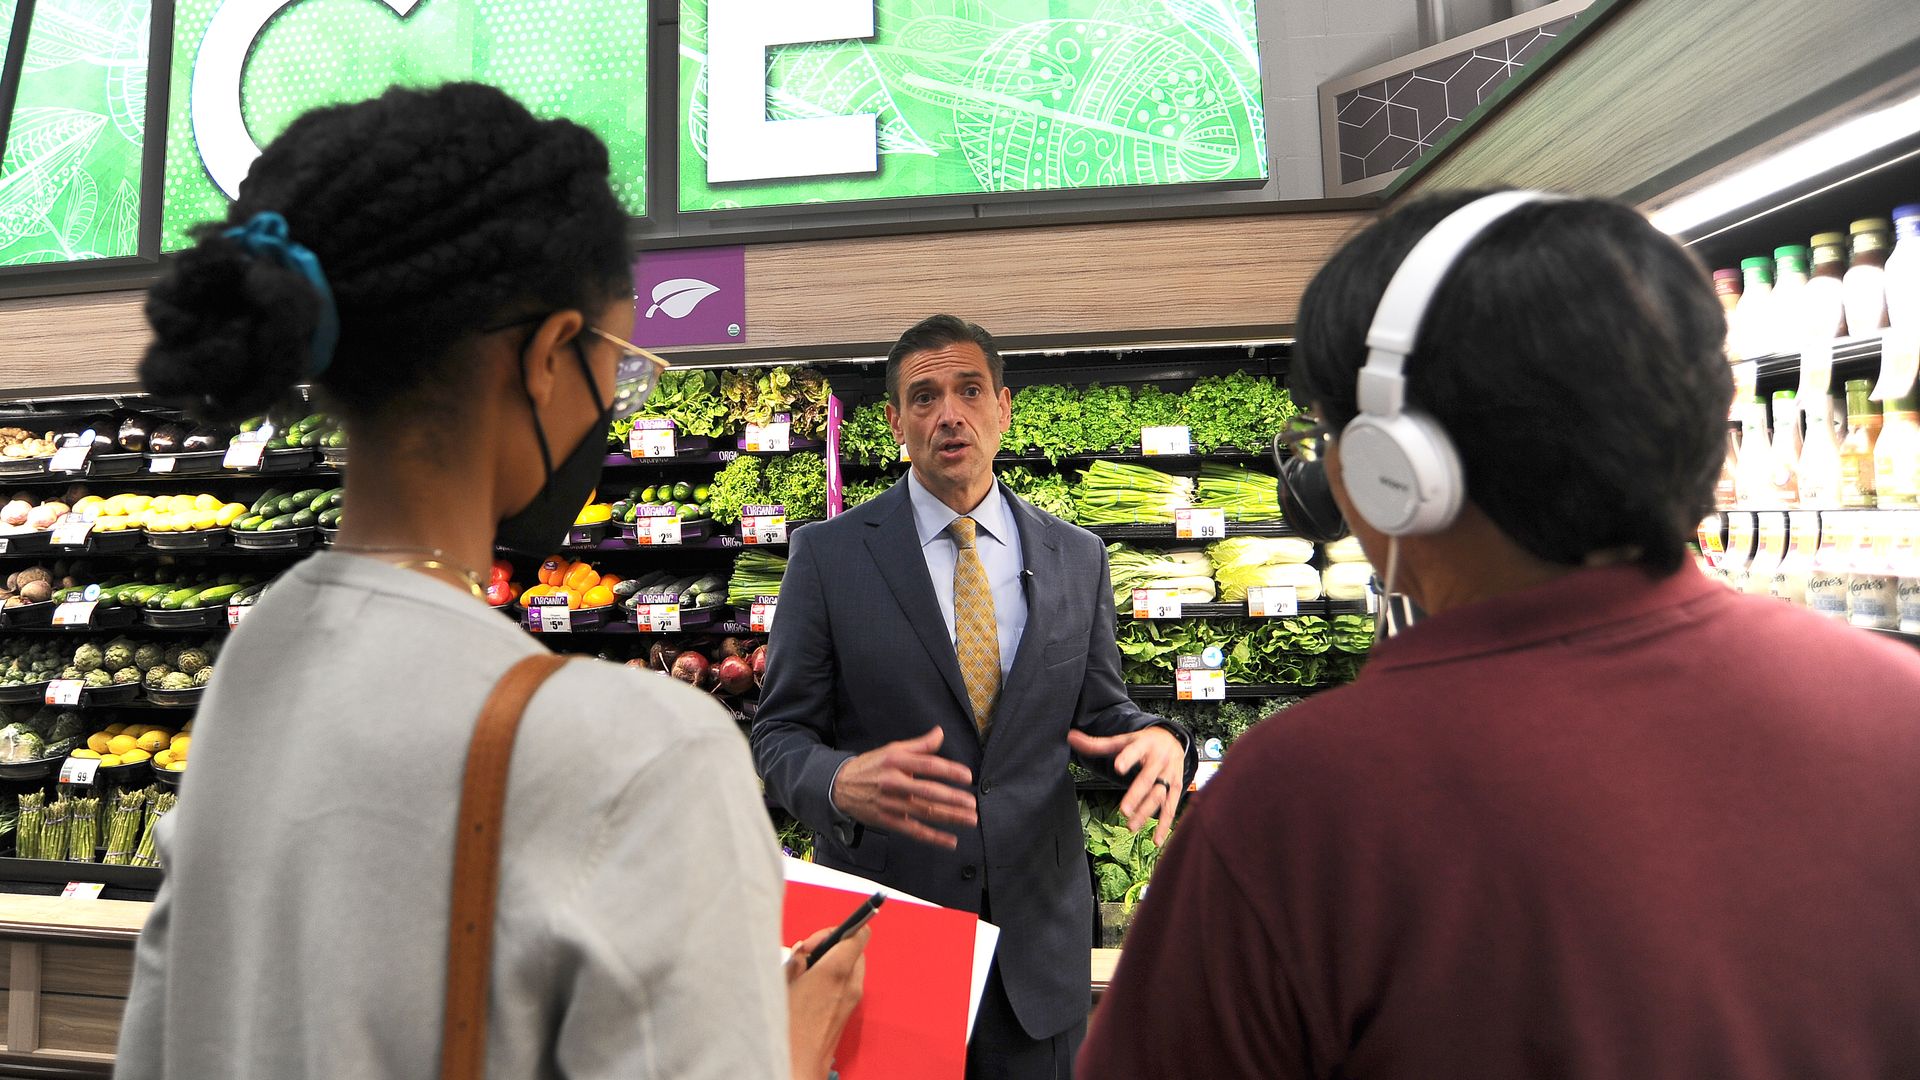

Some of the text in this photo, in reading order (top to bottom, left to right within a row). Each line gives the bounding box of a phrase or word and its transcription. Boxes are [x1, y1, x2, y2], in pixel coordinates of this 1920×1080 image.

[718, 450, 739, 461] ORGA
[640, 507, 672, 516] ORGANIC
[746, 506, 779, 516] ORGANIC
[534, 596, 565, 605] ORGANIC
[642, 595, 674, 604] ORGANIC
[758, 596, 779, 604] ORGA
